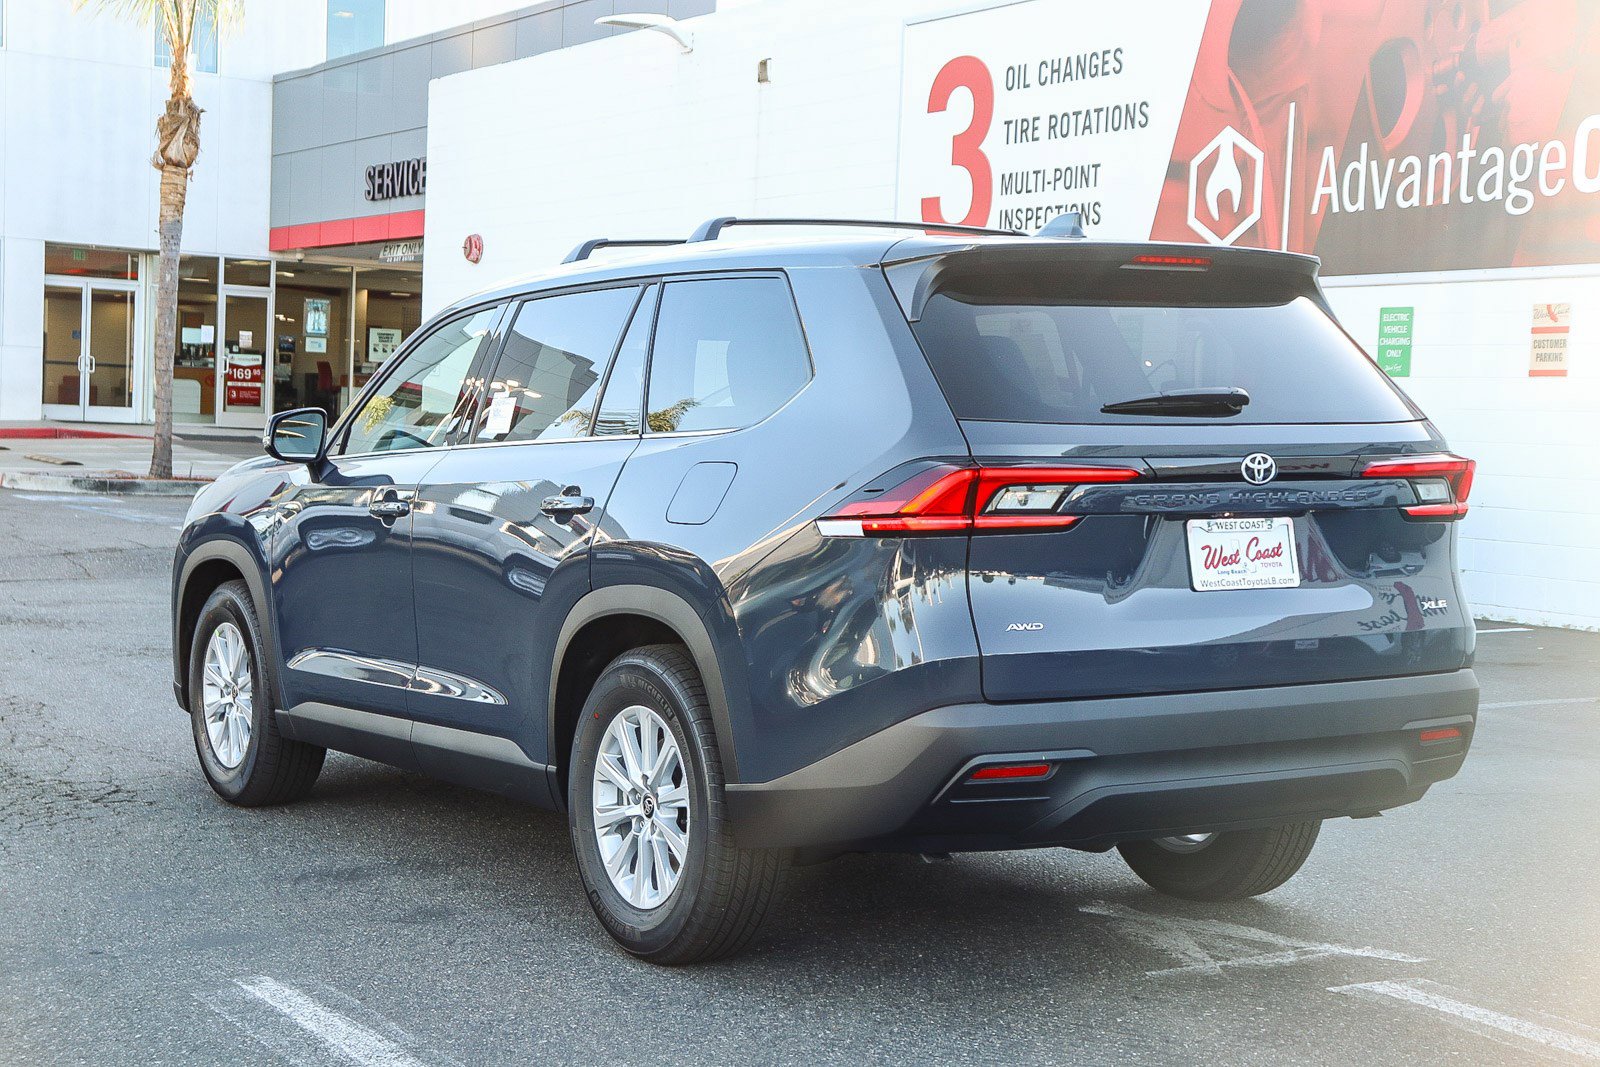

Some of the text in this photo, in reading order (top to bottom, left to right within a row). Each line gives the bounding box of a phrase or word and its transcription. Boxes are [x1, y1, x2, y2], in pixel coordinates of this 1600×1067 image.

[1005, 47, 1124, 91] OIL CHANGES
[1003, 101, 1150, 145] TIRE ROTATIONS
[921, 55, 994, 236] 3
[364, 157, 427, 201] SERVICE
[1000, 163, 1101, 196] MULTI-POINT
[383, 242, 423, 256] EXIT ONLY
[1383, 313, 1410, 321] ELECTRIC
[1384, 325, 1408, 334] VEHICLE
[1380, 337, 1411, 346] CHARGING
[1533, 339, 1567, 349] CUSTOMER
[1386, 349, 1402, 358] ONLY
[1536, 352, 1562, 362] PARKING
[231, 390, 237, 399] 3
[1134, 490, 1368, 505] GRAND HIGHLANDER
[1215, 520, 1265, 530] WEST COAST
[1201, 536, 1283, 570] West Coast
[1200, 577, 1295, 588] WestCoastToyotaLB.com
[1420, 599, 1448, 610] XLE
[1005, 622, 1044, 632] AWD
[637, 679, 674, 719] MICHELIN
